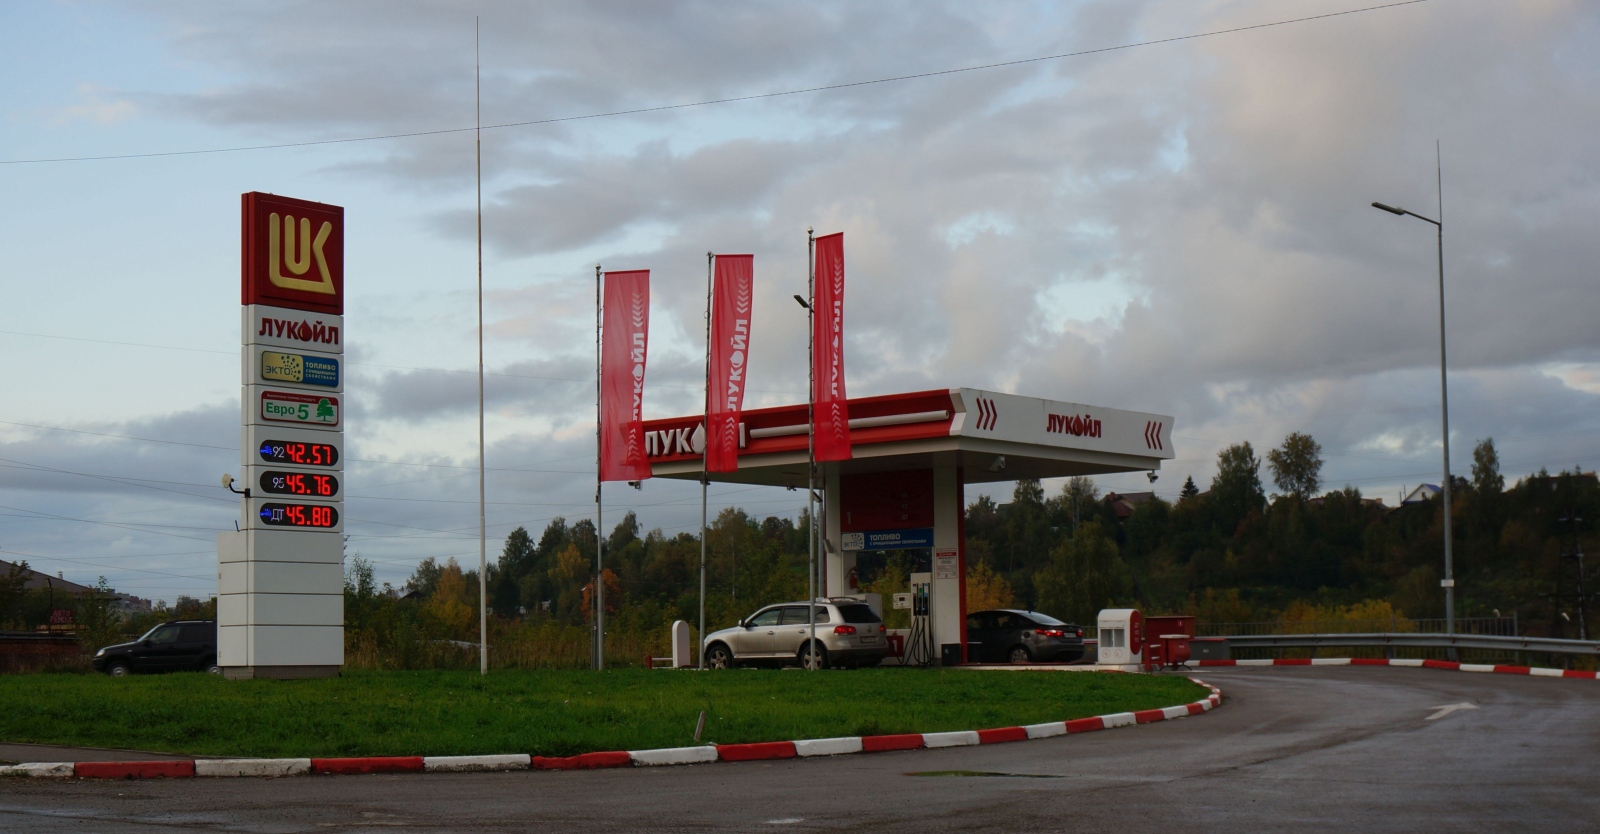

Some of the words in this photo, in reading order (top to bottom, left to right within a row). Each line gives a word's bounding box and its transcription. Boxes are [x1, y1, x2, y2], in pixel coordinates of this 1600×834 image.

[259, 317, 339, 345] ЛУКОЙЛ
[265, 365, 291, 376] ЭКТО
[305, 362, 336, 371] ТОПЛИВО
[727, 319, 748, 412] ЛУКОЙЛ
[630, 332, 645, 423] ЛУКОЙЛ
[266, 402, 295, 416] Евро
[297, 404, 310, 420] 5
[1047, 413, 1102, 438] ЛУКОЙЛ
[272, 446, 285, 458] 92
[286, 444, 331, 465] 42.57
[272, 477, 285, 489] 95
[286, 475, 331, 495] 45.76
[271, 508, 285, 522] ДТ
[286, 506, 331, 527] 45.80
[869, 533, 901, 541] ТОПЛИВО
[891, 639, 898, 653] 1
